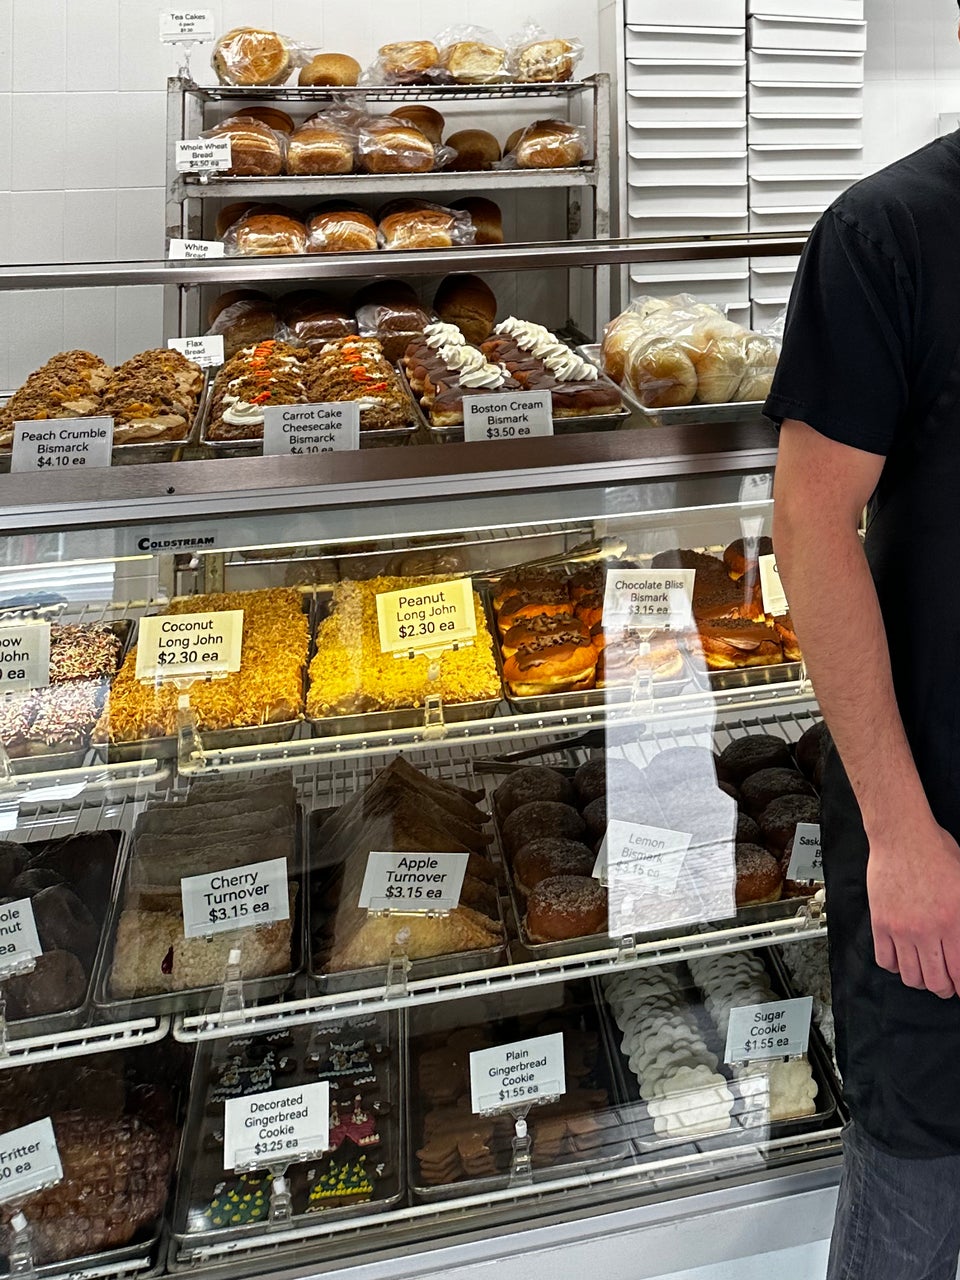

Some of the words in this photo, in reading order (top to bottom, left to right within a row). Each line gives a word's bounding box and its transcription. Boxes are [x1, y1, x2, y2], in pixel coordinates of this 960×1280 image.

[192, 151, 213, 159] Bread
[184, 243, 209, 251] White
[471, 404, 507, 414] Boston
[509, 401, 543, 411] Cream
[282, 411, 315, 421] Carrot
[317, 409, 343, 419] Cake
[487, 413, 529, 425] Bismark
[282, 421, 343, 433] Cheesecake
[486, 426, 515, 439] $3.50
[518, 427, 531, 435] ea
[21, 430, 56, 441] Peach
[59, 428, 107, 440] Crumble
[289, 433, 335, 445] Bismarck
[37, 442, 90, 454] Bismarck
[290, 446, 319, 455] $410
[36, 455, 70, 468] $4.10
[72, 457, 86, 465] ea
[615, 579, 663, 590] Chocolate
[664, 580, 684, 589] Bliss
[398, 591, 446, 609] Peanut
[630, 593, 668, 602] Bismark
[396, 610, 426, 622] Long
[428, 605, 457, 617] John
[628, 604, 655, 615] $3.15
[656, 606, 669, 615] ea
[161, 619, 214, 632] Coconut
[398, 621, 436, 639] $2.30
[439, 620, 455, 631] ea
[158, 637, 190, 650] Long
[192, 634, 223, 646] John
[157, 650, 198, 667] $2.30
[201, 652, 219, 662] ea
[7, 669, 26, 680] ea
[628, 833, 666, 849] Lemon
[799, 836, 821, 846] Sask
[397, 857, 438, 871] Apple
[210, 872, 258, 890] Cherry
[386, 871, 447, 883] Turnover
[203, 884, 269, 906] Turnover
[385, 885, 423, 900] $3.15
[426, 888, 443, 898] ea
[208, 903, 249, 923] $3.15
[252, 901, 270, 913] ea
[753, 1010, 786, 1023] Sugar
[750, 1023, 787, 1036] Cookie
[744, 1037, 774, 1052] $1.55
[776, 1037, 790, 1047] ea
[505, 1049, 529, 1061] Plain
[488, 1056, 547, 1077] Gingerbread
[502, 1073, 535, 1087] Cookie
[498, 1086, 525, 1101] $1.55
[527, 1085, 539, 1094] ea
[250, 1094, 303, 1113] Decorated
[244, 1106, 309, 1128] Gingerbread
[258, 1125, 295, 1140] Cookie
[0, 1141, 41, 1164] Fritter
[254, 1139, 284, 1156] $3.25
[285, 1138, 299, 1149] ea
[15, 1161, 32, 1174] ea
